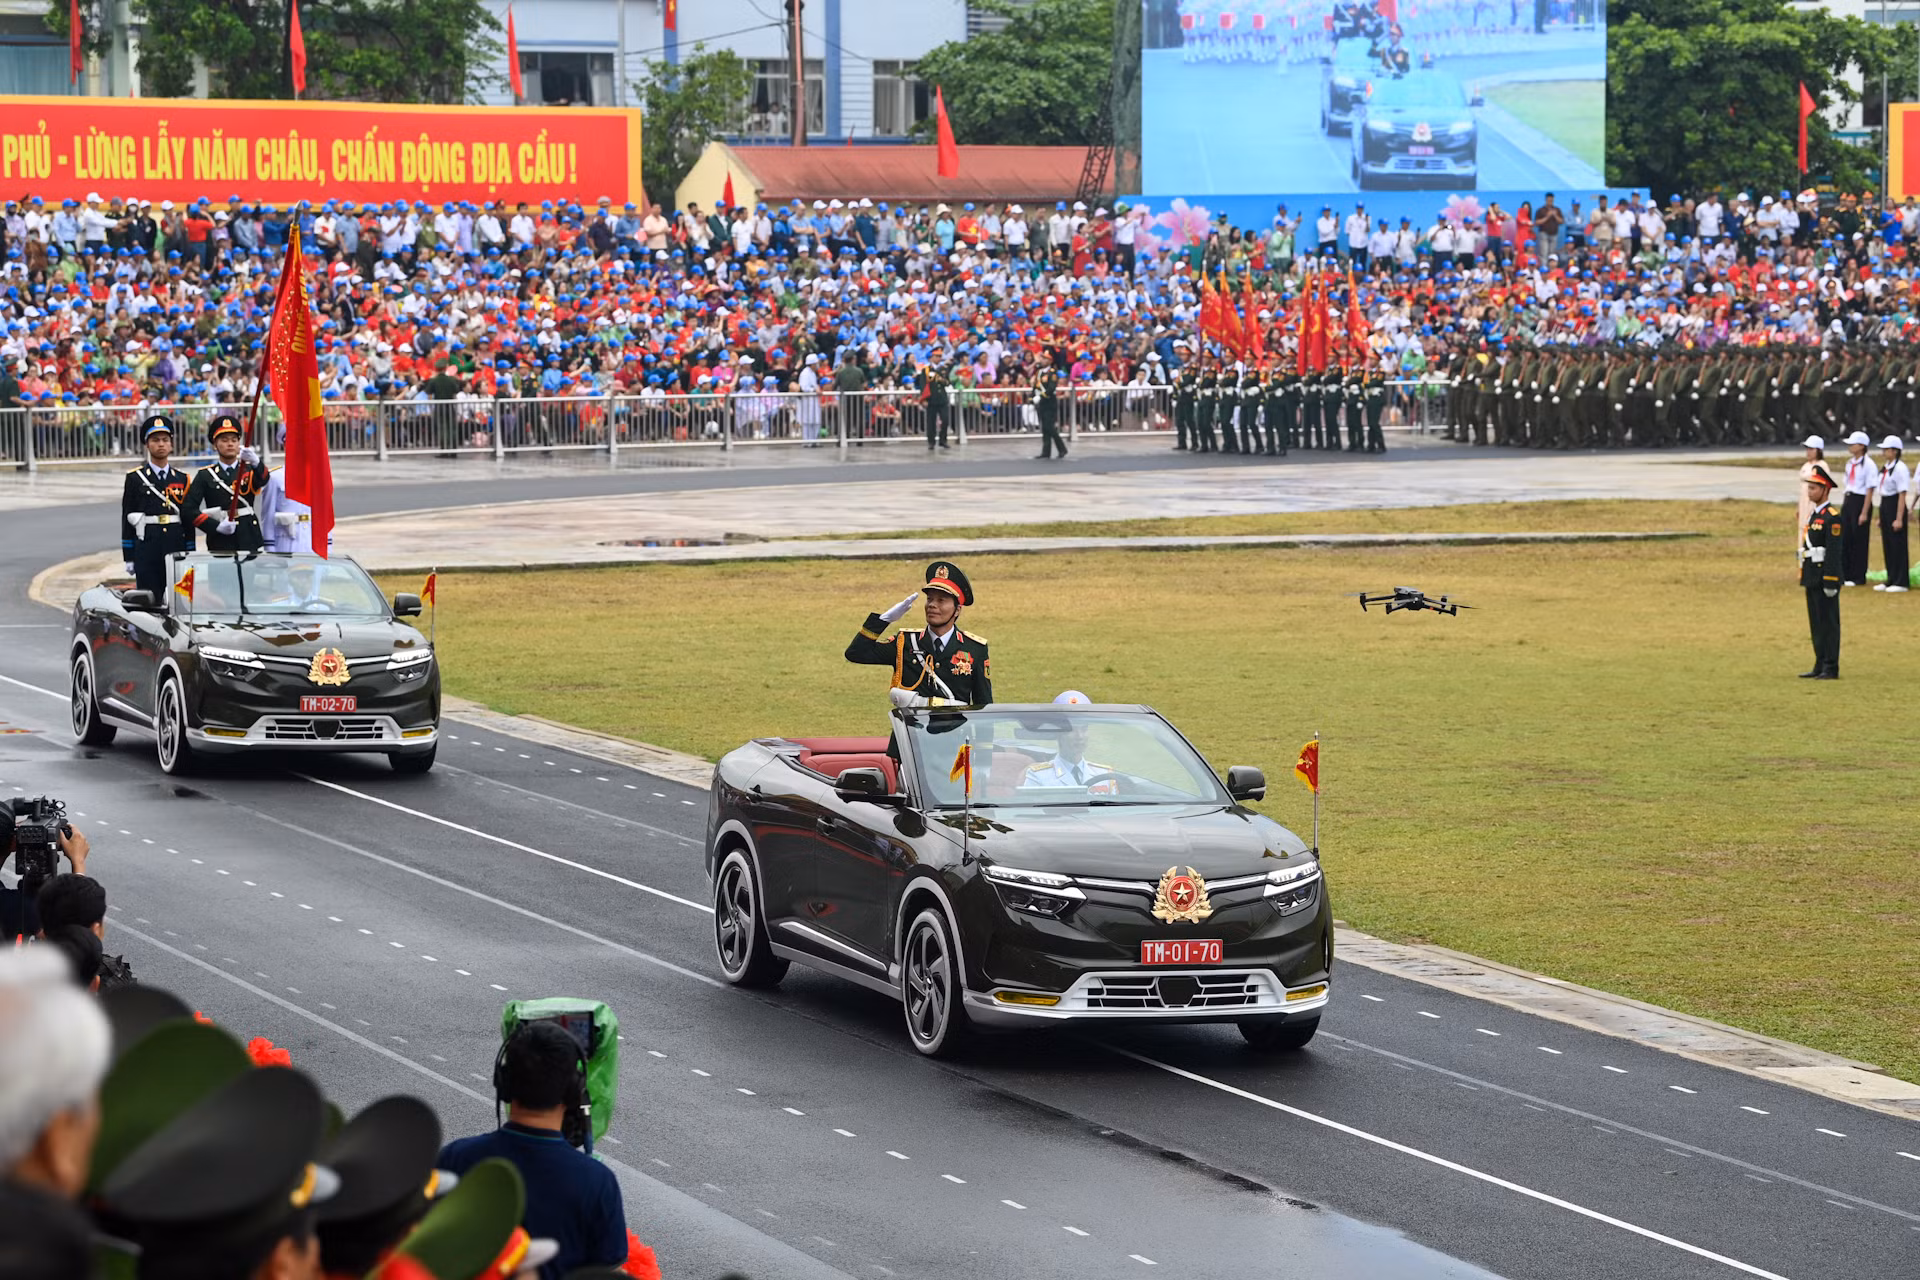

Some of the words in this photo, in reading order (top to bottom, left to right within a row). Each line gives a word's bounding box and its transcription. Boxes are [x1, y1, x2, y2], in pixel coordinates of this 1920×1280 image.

[2, 119, 51, 179] PHỦ
[73, 126, 137, 180] LỪNG
[143, 120, 186, 180] LẪY
[193, 128, 249, 181] NĂM
[255, 129, 325, 187] CHÂU,
[332, 125, 396, 183] CHẤN
[401, 132, 466, 193] ĐỘNG
[471, 141, 513, 193] ĐỊA
[302, 698, 355, 711] TM-02-70
[1144, 942, 1220, 963] TM-01-70
